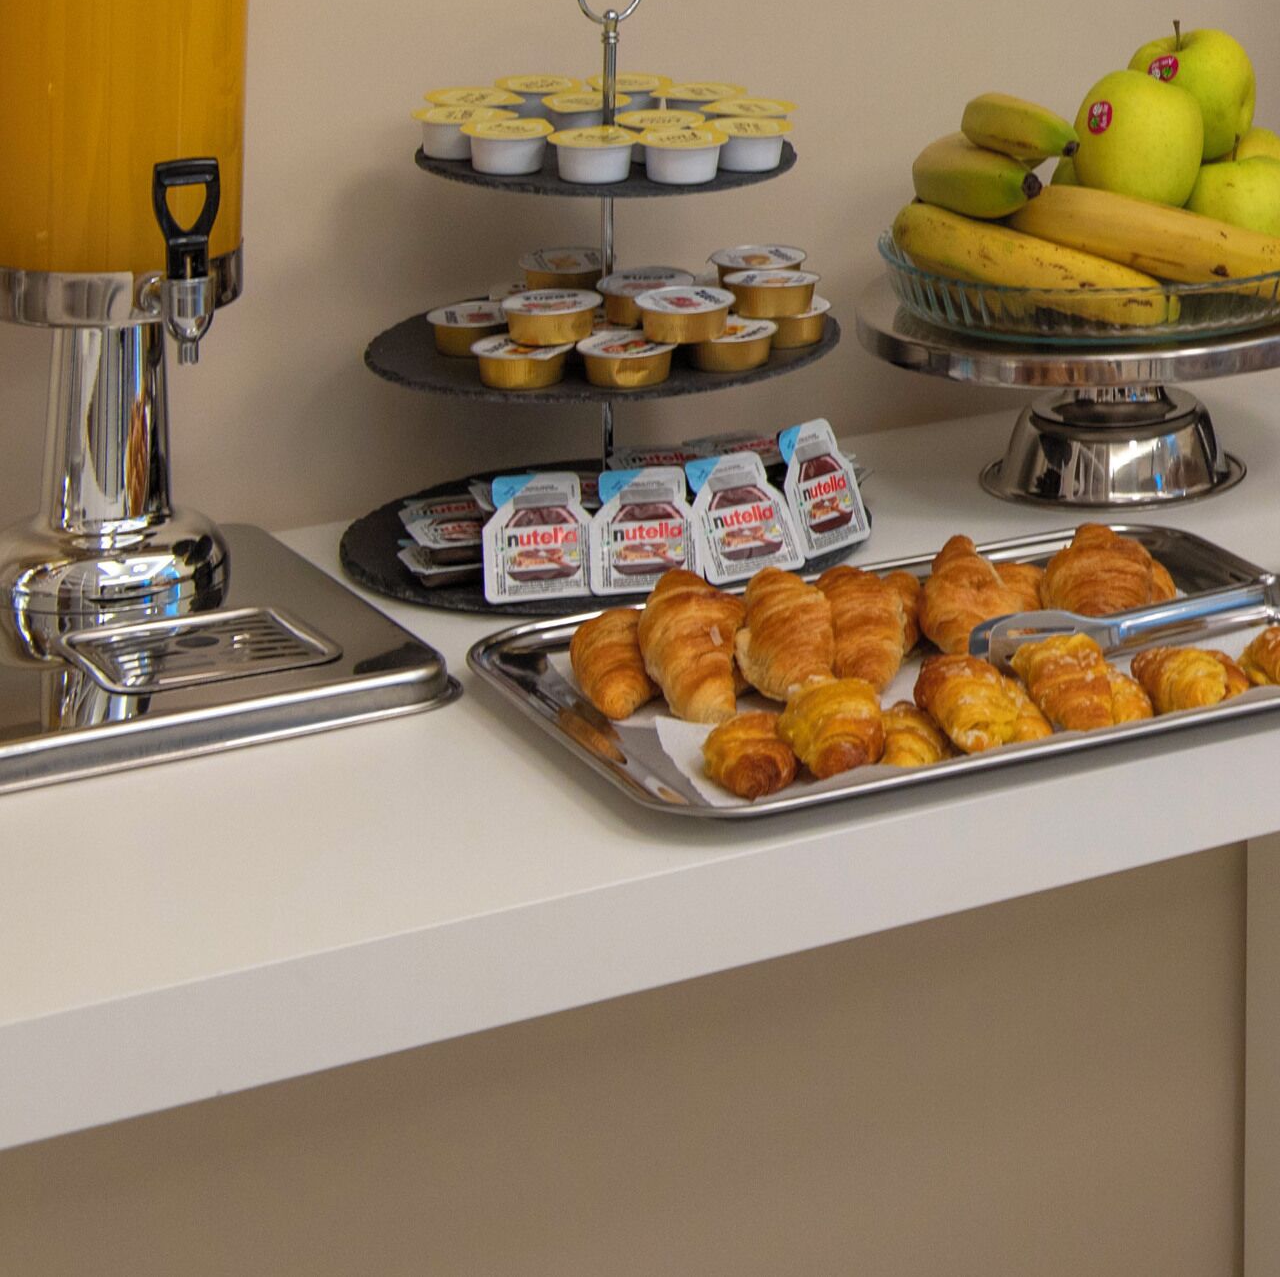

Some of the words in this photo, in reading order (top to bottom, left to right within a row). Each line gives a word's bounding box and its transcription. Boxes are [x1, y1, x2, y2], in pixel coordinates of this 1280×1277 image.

[802, 475, 847, 503] nutella
[713, 504, 775, 528] nutella
[507, 526, 578, 548] nutella
[612, 523, 684, 544] nutella
